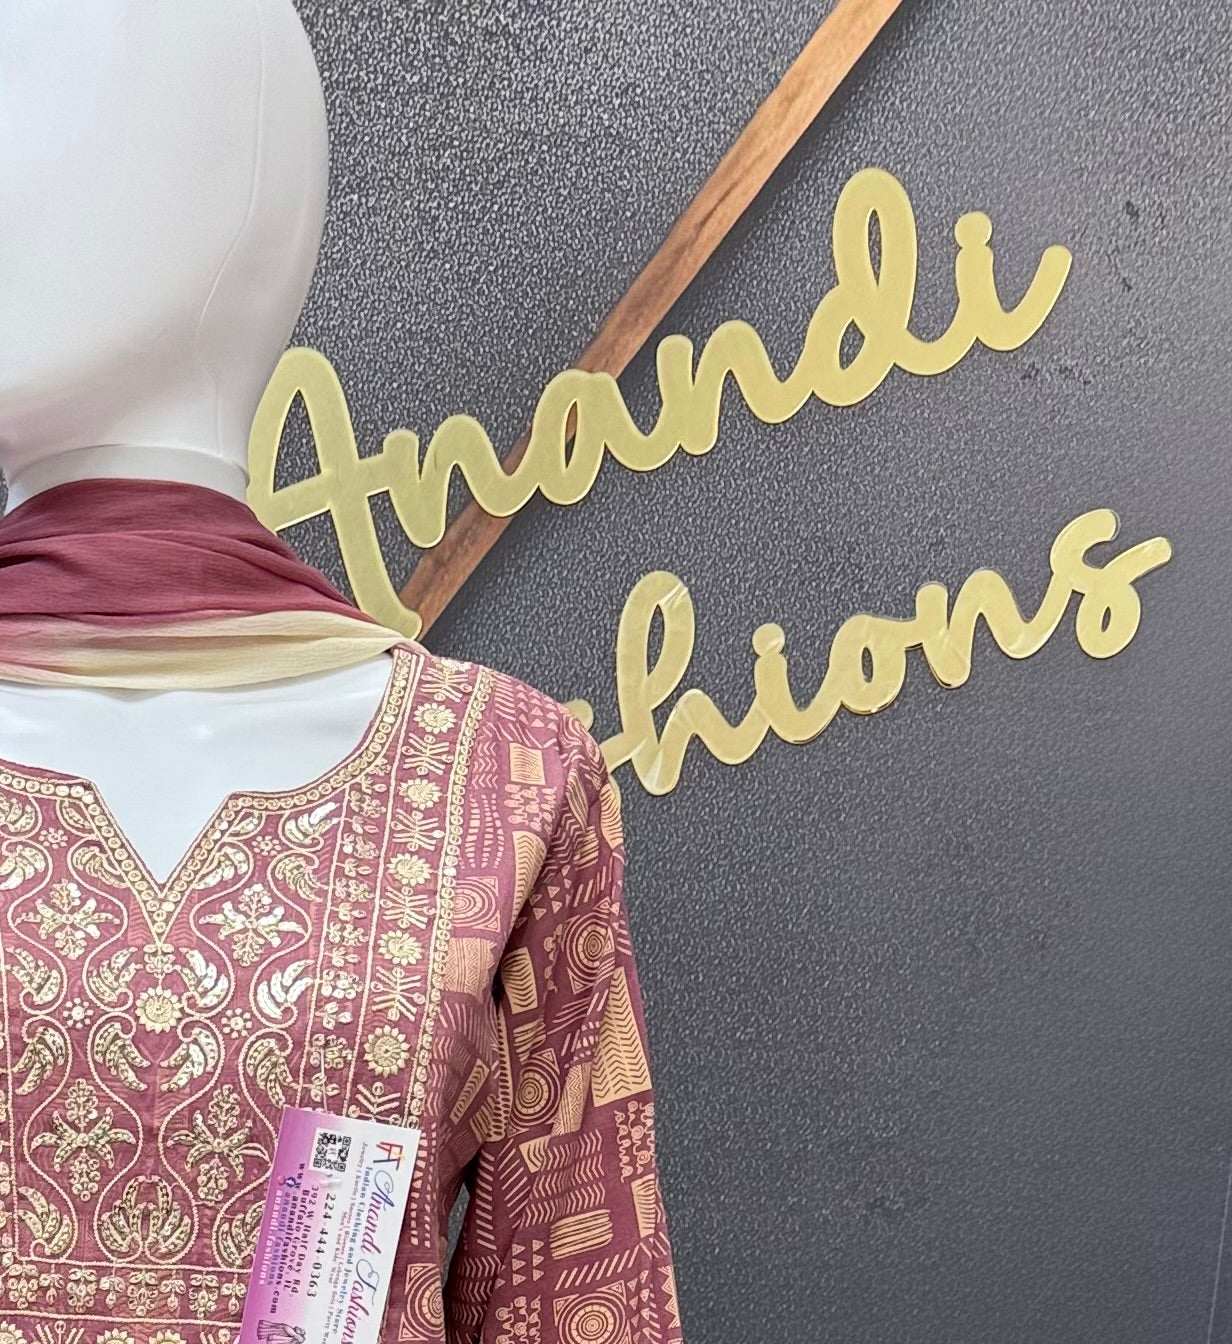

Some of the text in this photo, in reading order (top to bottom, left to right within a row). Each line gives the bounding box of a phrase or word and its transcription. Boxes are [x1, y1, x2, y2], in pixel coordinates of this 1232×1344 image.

[246, 166, 1073, 641] Anandi
[294, 1189, 310, 1232] Buffalo
[305, 1209, 314, 1220] W
[308, 1184, 319, 1205] 392
[360, 1169, 395, 1255] Anandi
[270, 1162, 306, 1314] www.anandifashions.com
[292, 1252, 305, 1273] Day
[299, 1224, 311, 1250] Half
[306, 1192, 336, 1297] 224-444-0363
[331, 1166, 373, 1334] Indian Clothing and Jewelry Store
